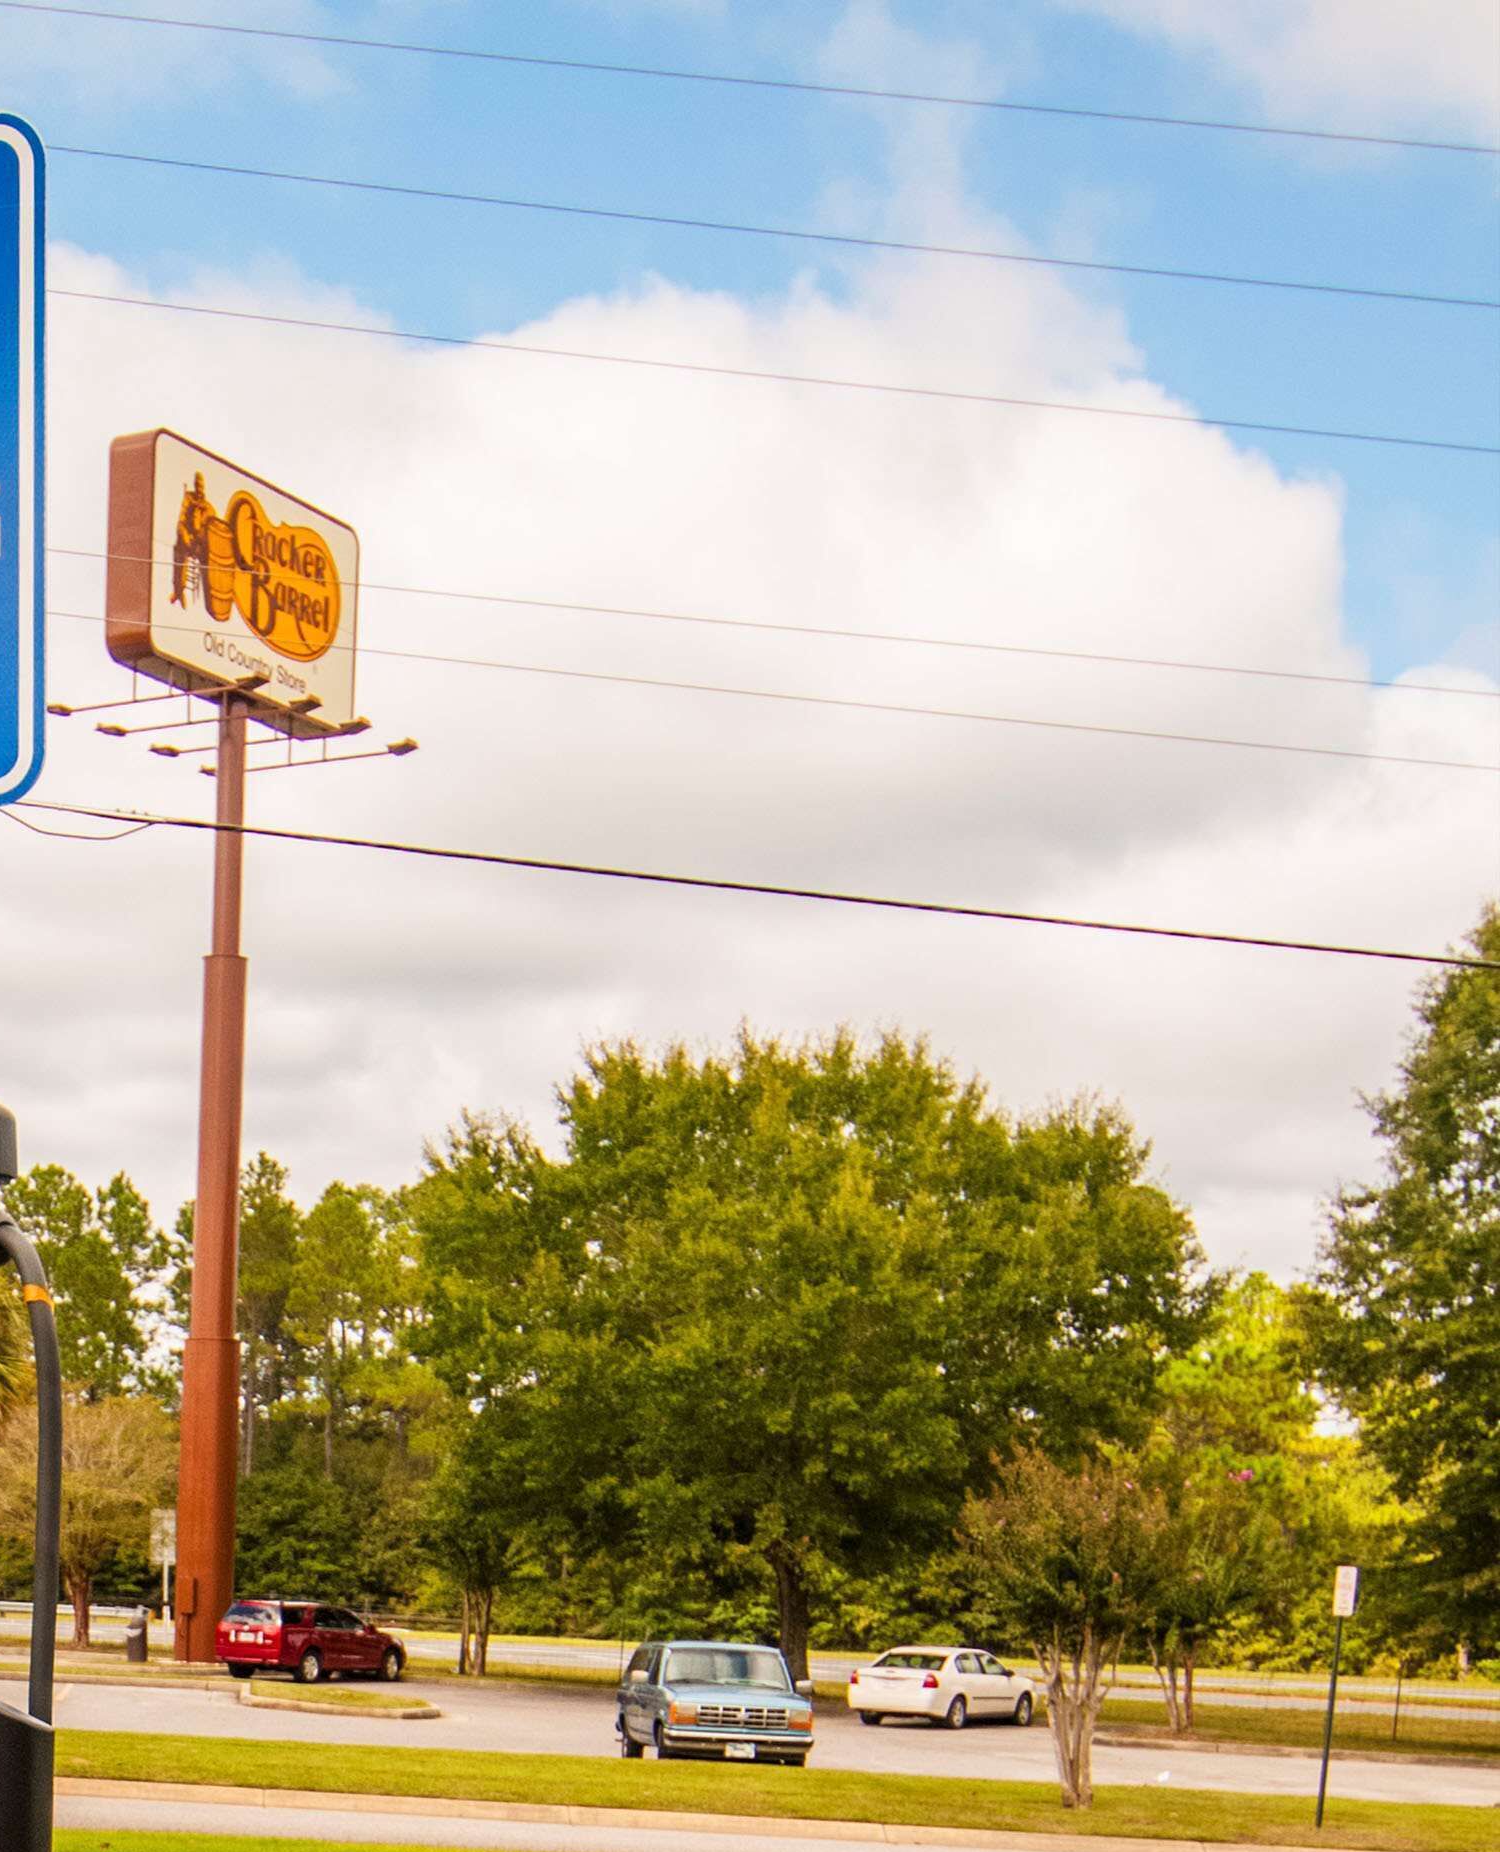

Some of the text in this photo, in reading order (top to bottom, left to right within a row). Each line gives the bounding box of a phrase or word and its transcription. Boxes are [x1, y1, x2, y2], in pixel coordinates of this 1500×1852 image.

[230, 498, 327, 588] Cracker
[249, 556, 329, 638] Barrel
[203, 631, 307, 694] Old Country Store
